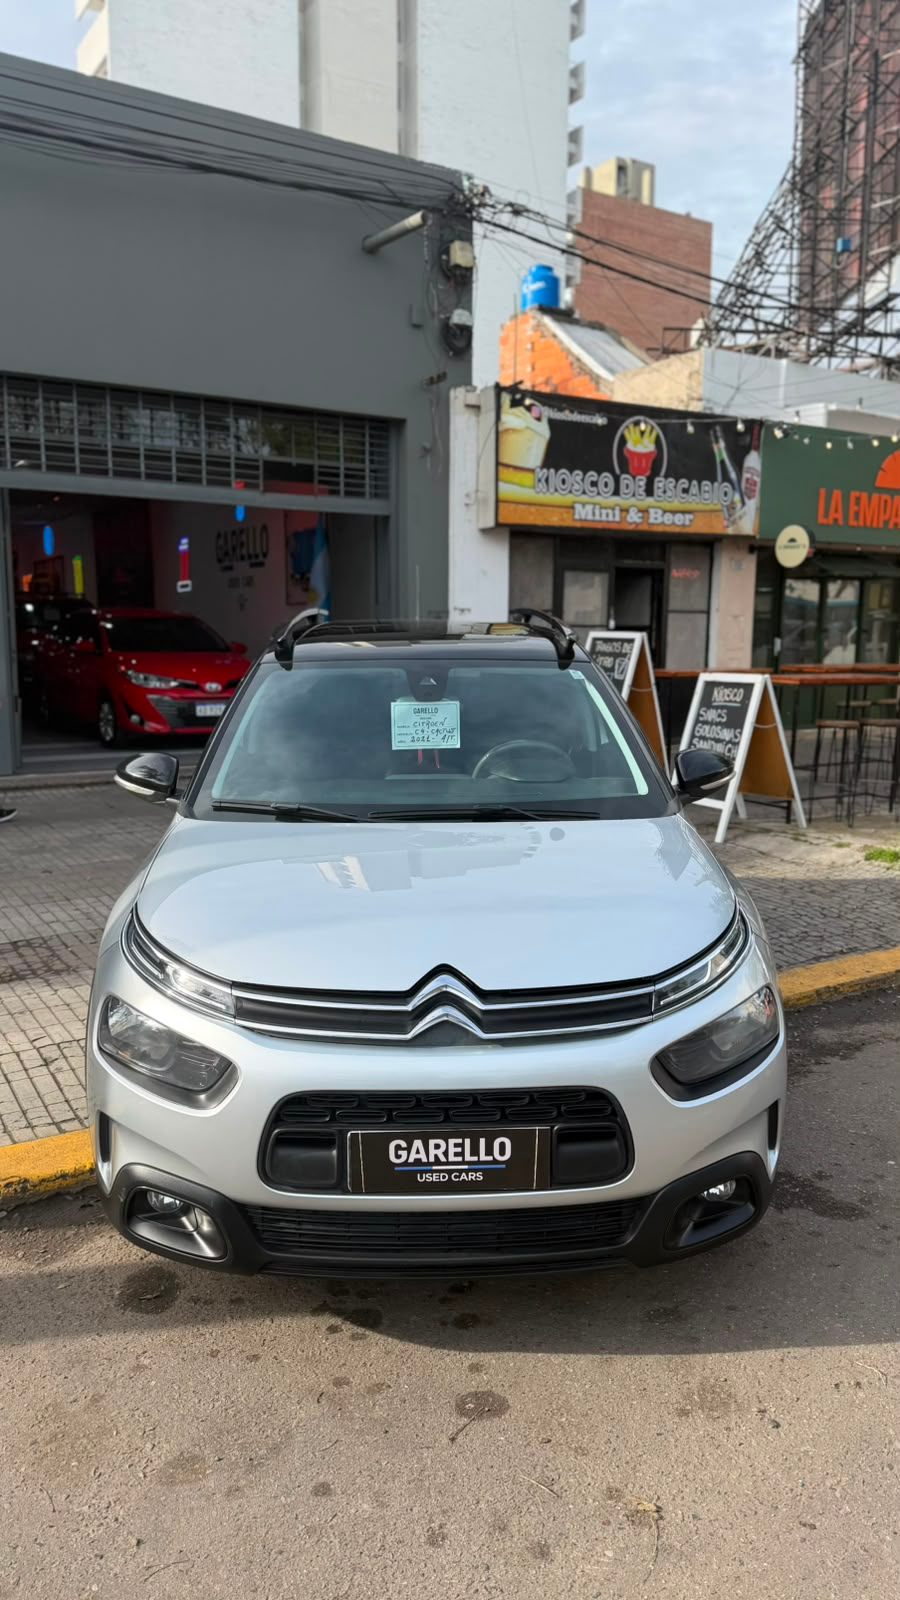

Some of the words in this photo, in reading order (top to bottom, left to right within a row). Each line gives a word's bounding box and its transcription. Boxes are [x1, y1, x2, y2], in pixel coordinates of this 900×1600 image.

[534, 468, 615, 498] KIOSCO
[619, 474, 647, 500] DE
[653, 476, 734, 505] ESCABIO
[573, 503, 621, 523] Mini
[626, 506, 643, 523] &
[647, 508, 694, 527] Beer
[818, 488, 843, 526] LA
[848, 490, 900, 528] EMPA
[215, 525, 269, 563] GARELLO
[388, 1137, 512, 1164] GARELLO
[417, 1173, 448, 1182] USED
[451, 1172, 483, 1182] CARS
